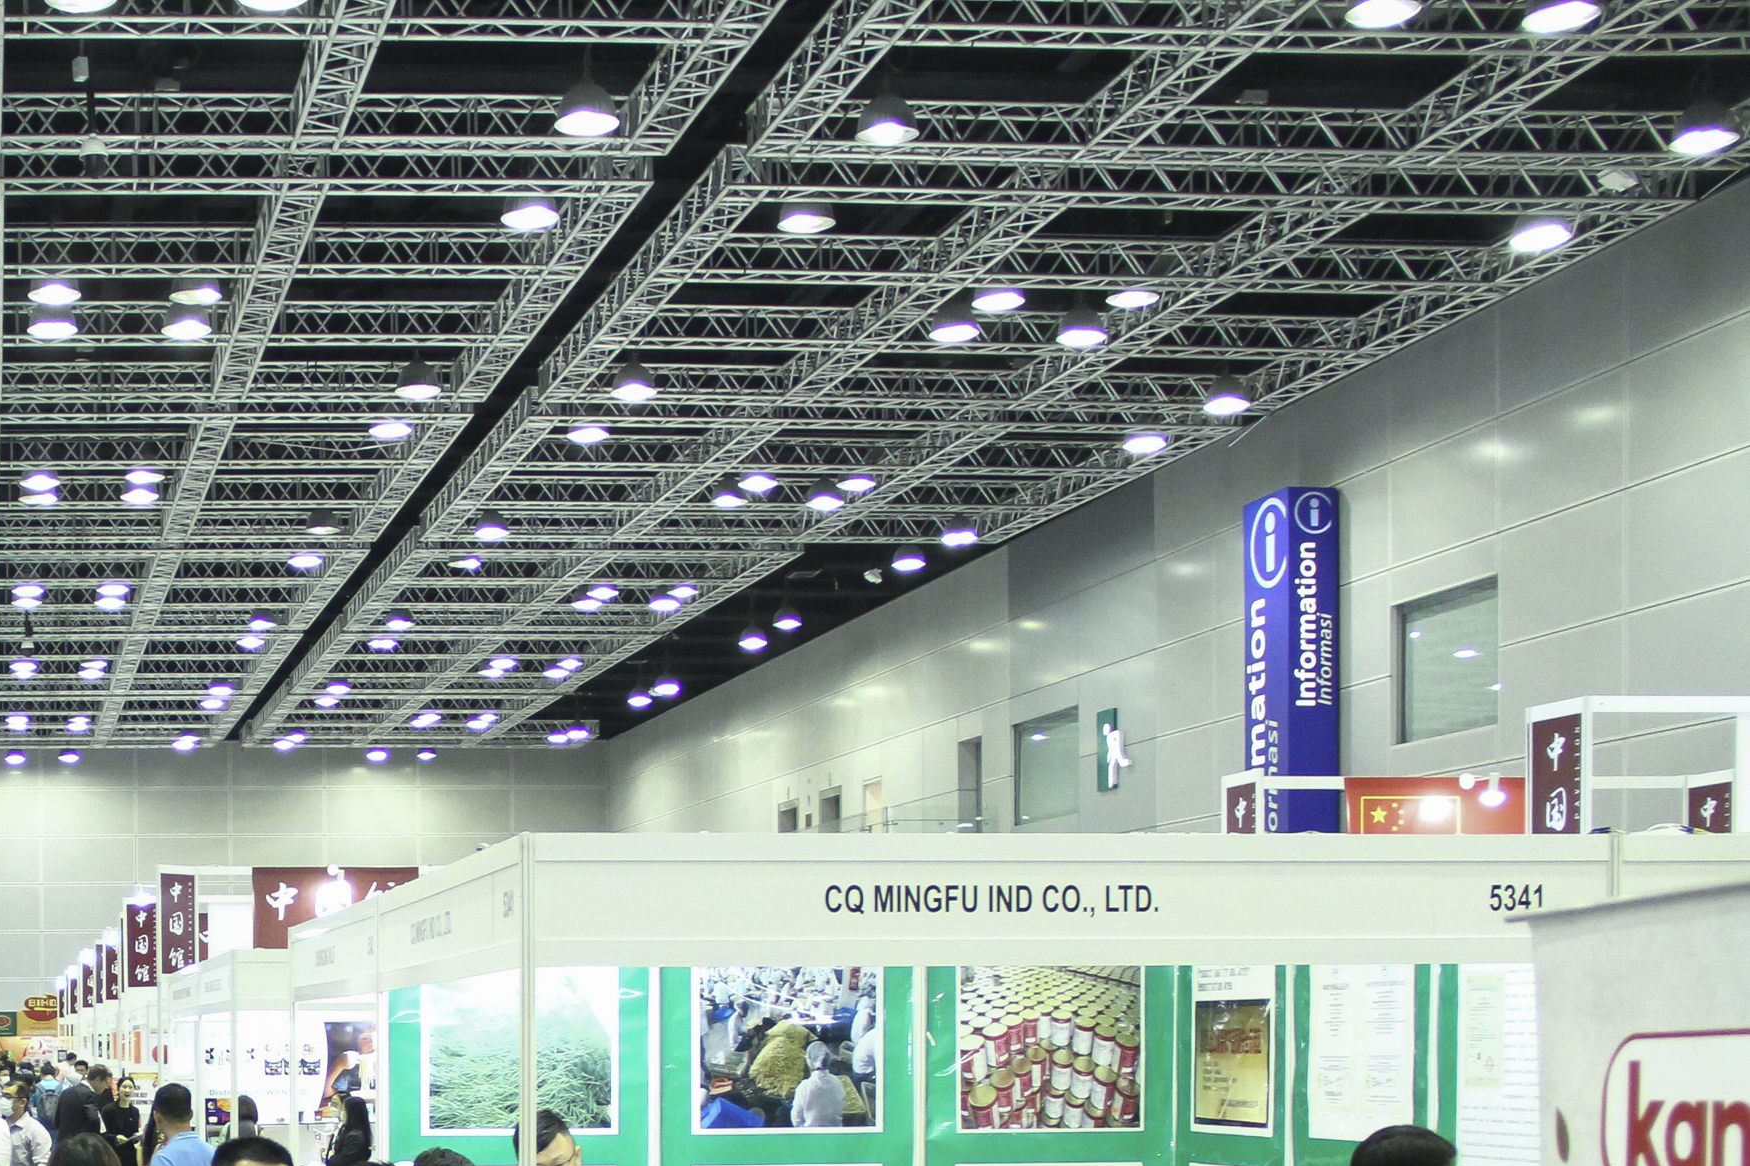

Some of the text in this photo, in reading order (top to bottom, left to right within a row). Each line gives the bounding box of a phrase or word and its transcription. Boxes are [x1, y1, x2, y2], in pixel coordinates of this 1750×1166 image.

[1294, 541, 1316, 707] Information
[1316, 612, 1333, 706] Informasi
[825, 884, 1159, 917] CQ MINGFU IND CO., LTD.
[1488, 884, 1543, 912] 5341
